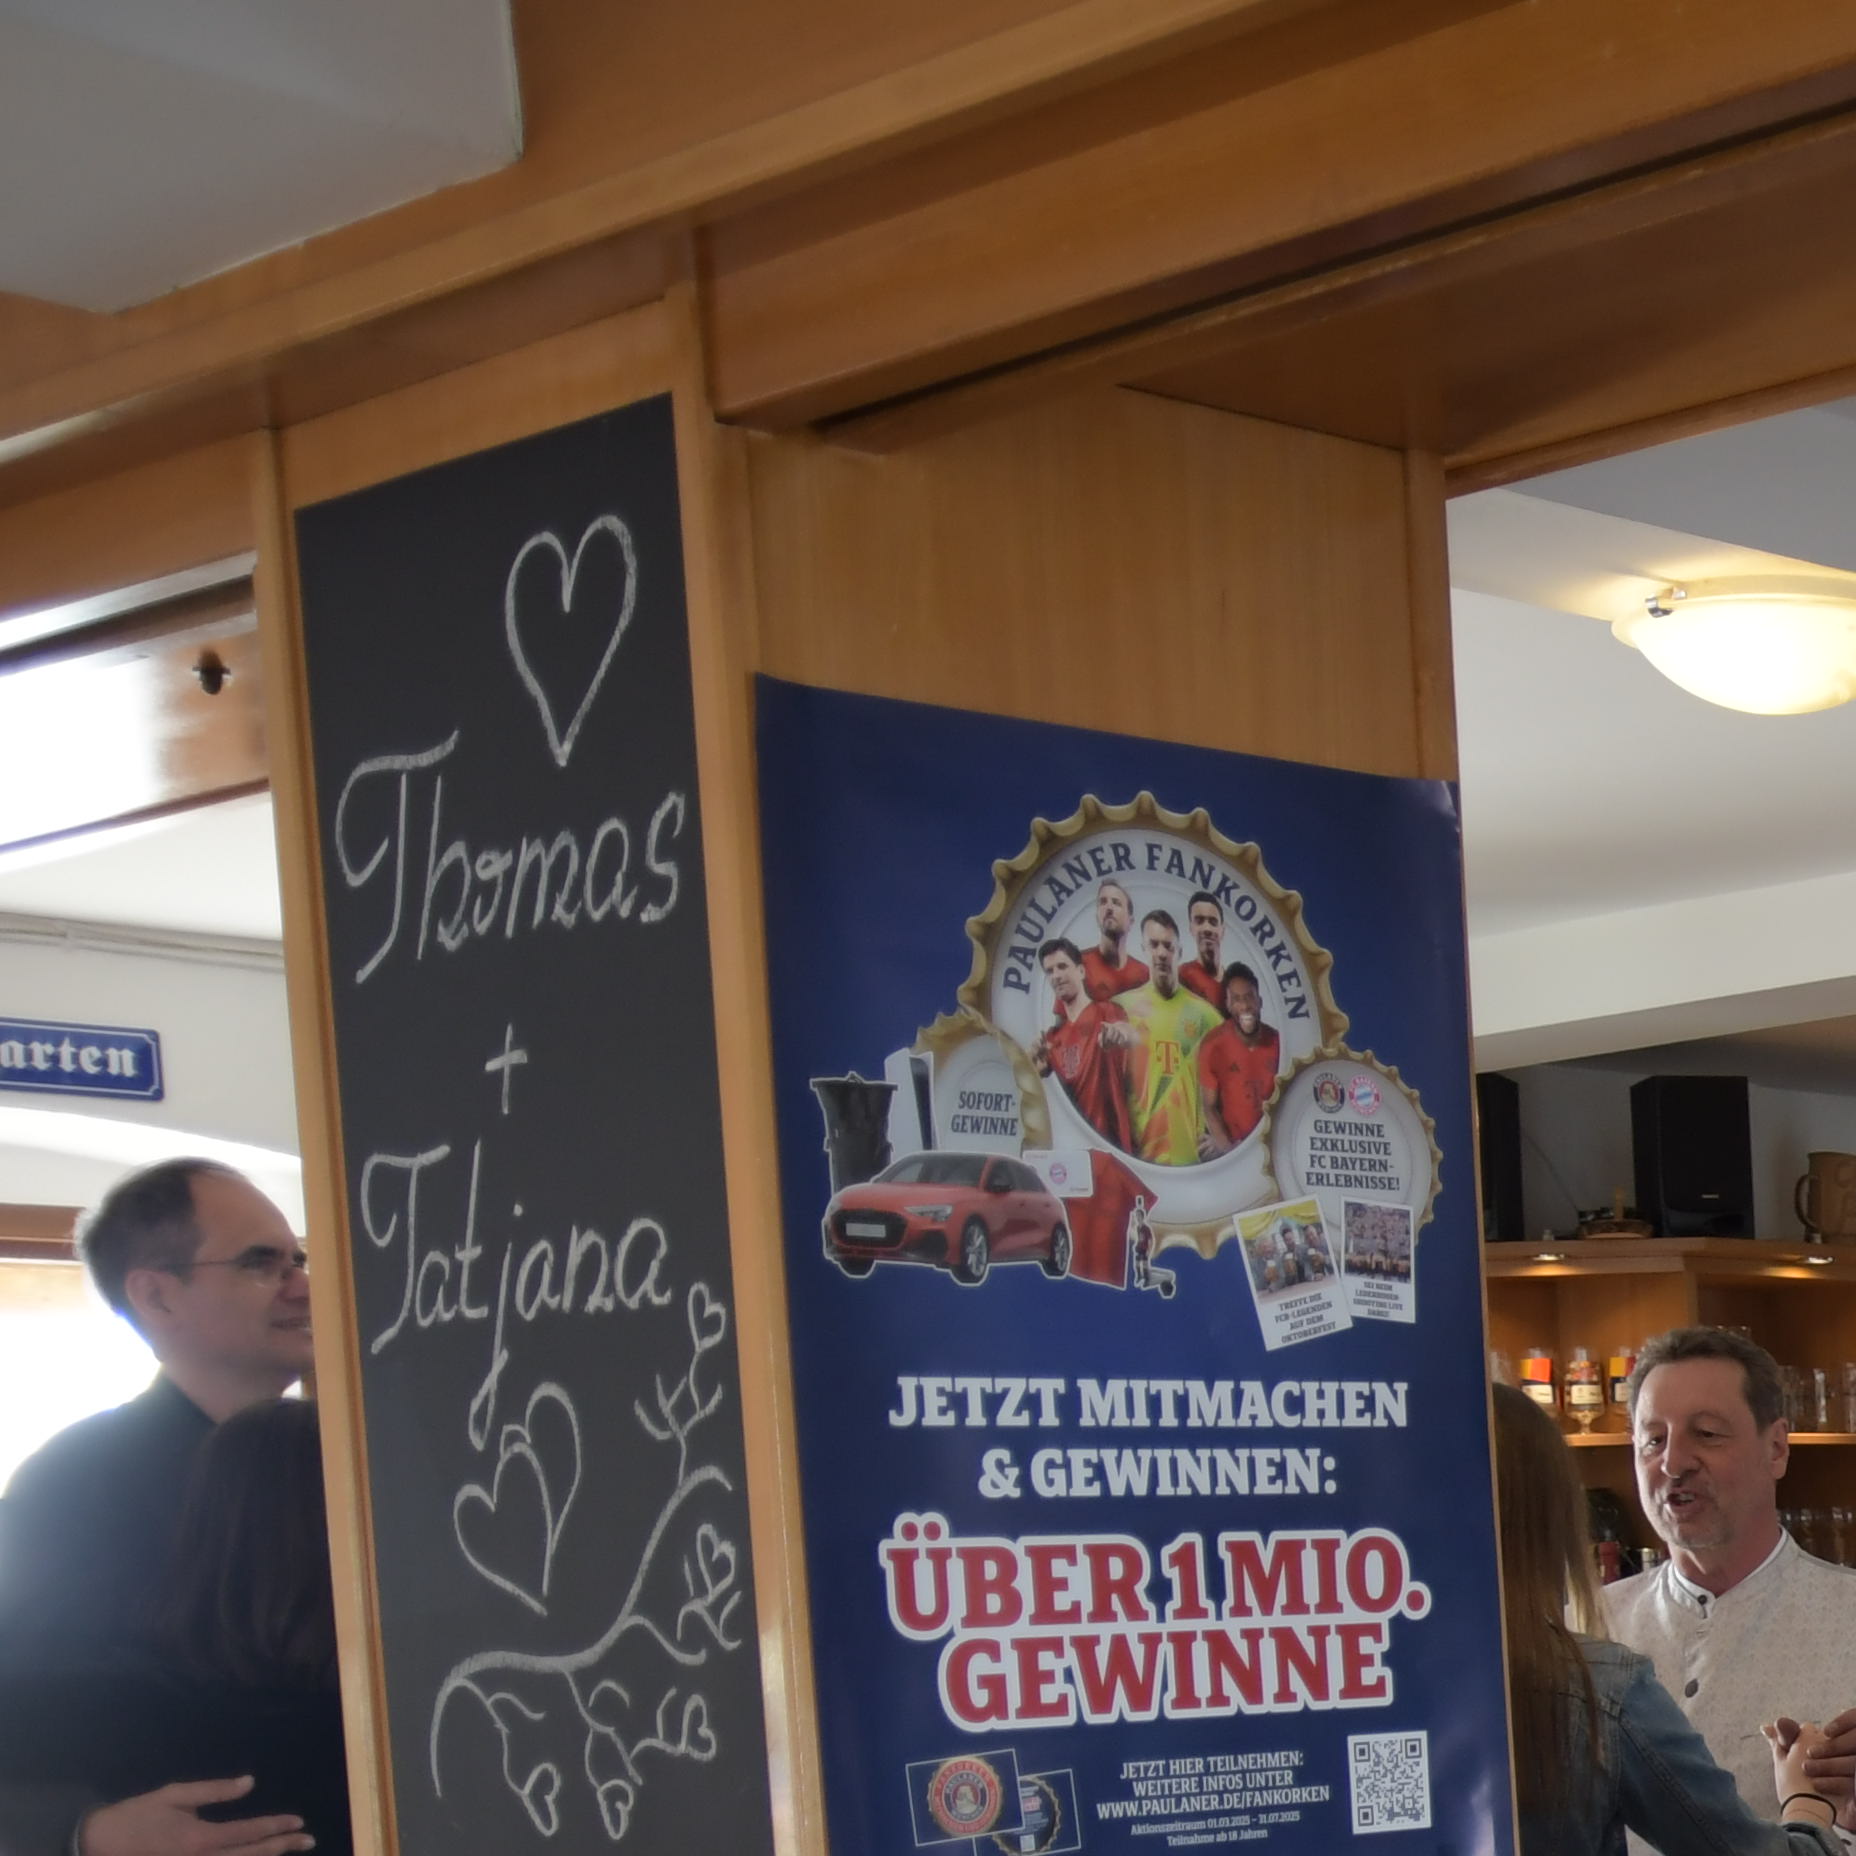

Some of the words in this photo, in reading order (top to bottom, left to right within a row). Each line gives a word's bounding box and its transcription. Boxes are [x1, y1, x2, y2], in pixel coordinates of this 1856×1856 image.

[335, 729, 684, 984] Thomas
[1002, 842, 1137, 995] PAULANER
[1145, 843, 1311, 1021] FANKORKEN
[0, 1037, 139, 1077] arten
[484, 1021, 529, 1115] +
[958, 1091, 1016, 1112] SOFORT-
[951, 1114, 1018, 1136] GEWINNE
[1313, 1119, 1384, 1138] GEWINNE
[1309, 1137, 1391, 1156] EXKLUSIVE
[1309, 1154, 1326, 1168] FC
[1330, 1155, 1394, 1172] BAYERN-
[1305, 1172, 1400, 1191] ERLEBNISSE!
[360, 1137, 672, 1449] Tatjana
[887, 1376, 1065, 1428] JETZT
[1076, 1377, 1408, 1428] MITMACHEN
[978, 1447, 1021, 1498] &
[1030, 1447, 1338, 1497] GEWINNEN:
[883, 1516, 1151, 1634] ÜBER
[1162, 1538, 1212, 1622] 1
[1221, 1533, 1426, 1618] MIO.
[943, 1620, 1389, 1725] GEWINNE
[1119, 1760, 1165, 1779] JETZT
[1169, 1758, 1204, 1776] HIER
[1206, 1750, 1304, 1773] TEILNEHMEN:
[1132, 1777, 1200, 1798] WEITERE
[1202, 1774, 1243, 1792] INFOS
[1244, 1769, 1294, 1788] UNTER
[1096, 1786, 1330, 1820] WWW.PAULANER.DE/FANKORKEN
